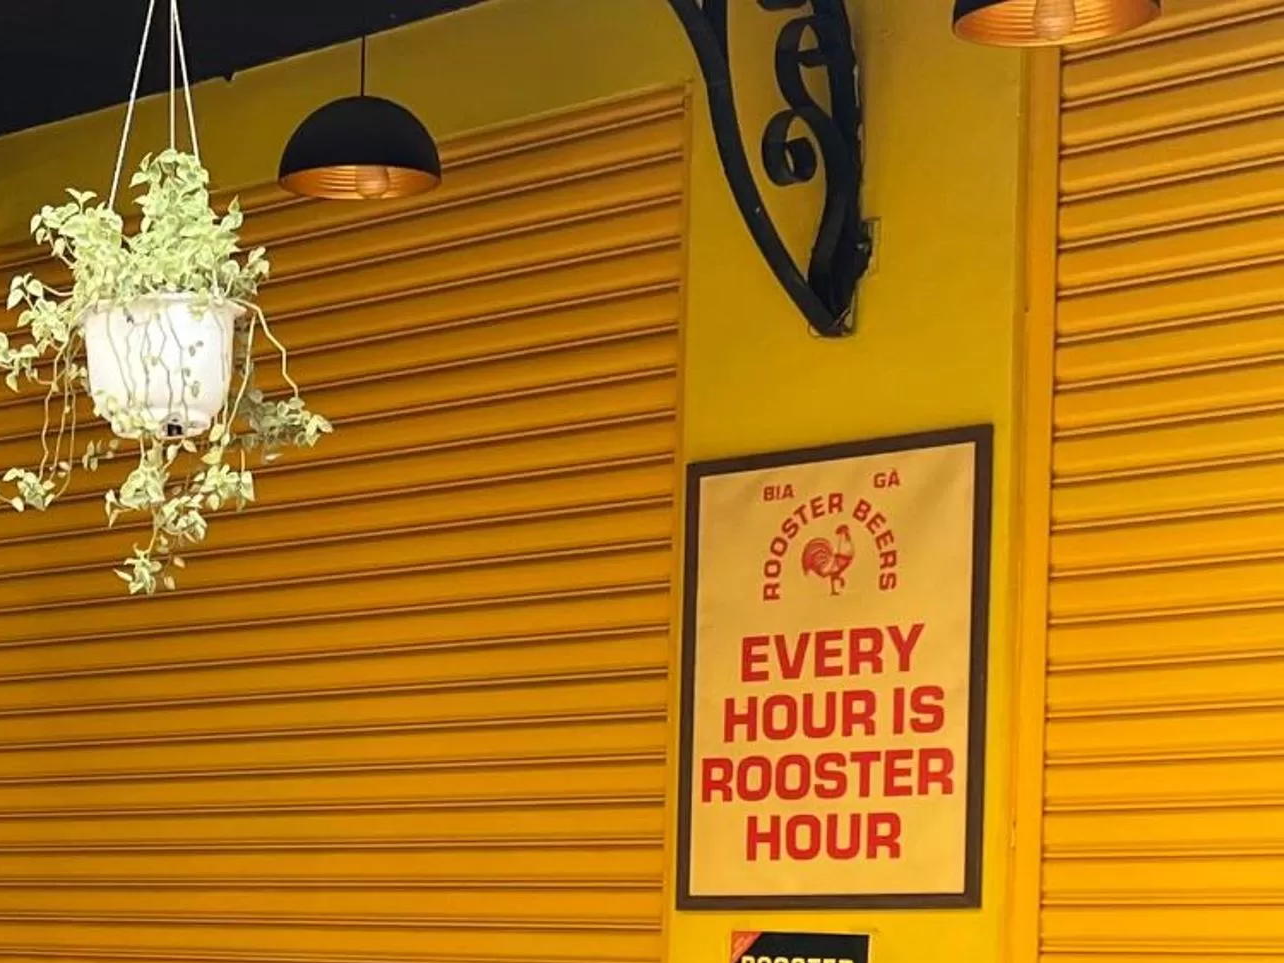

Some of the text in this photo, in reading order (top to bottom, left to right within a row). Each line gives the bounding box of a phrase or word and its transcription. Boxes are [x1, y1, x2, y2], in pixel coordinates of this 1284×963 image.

[763, 484, 794, 501] BIA
[763, 492, 897, 601] ROOSTER BEERS
[741, 623, 925, 682] EVERY
[723, 685, 945, 743] HOUR IS
[701, 747, 954, 803] ROOSTER
[746, 812, 902, 861] HOUR
